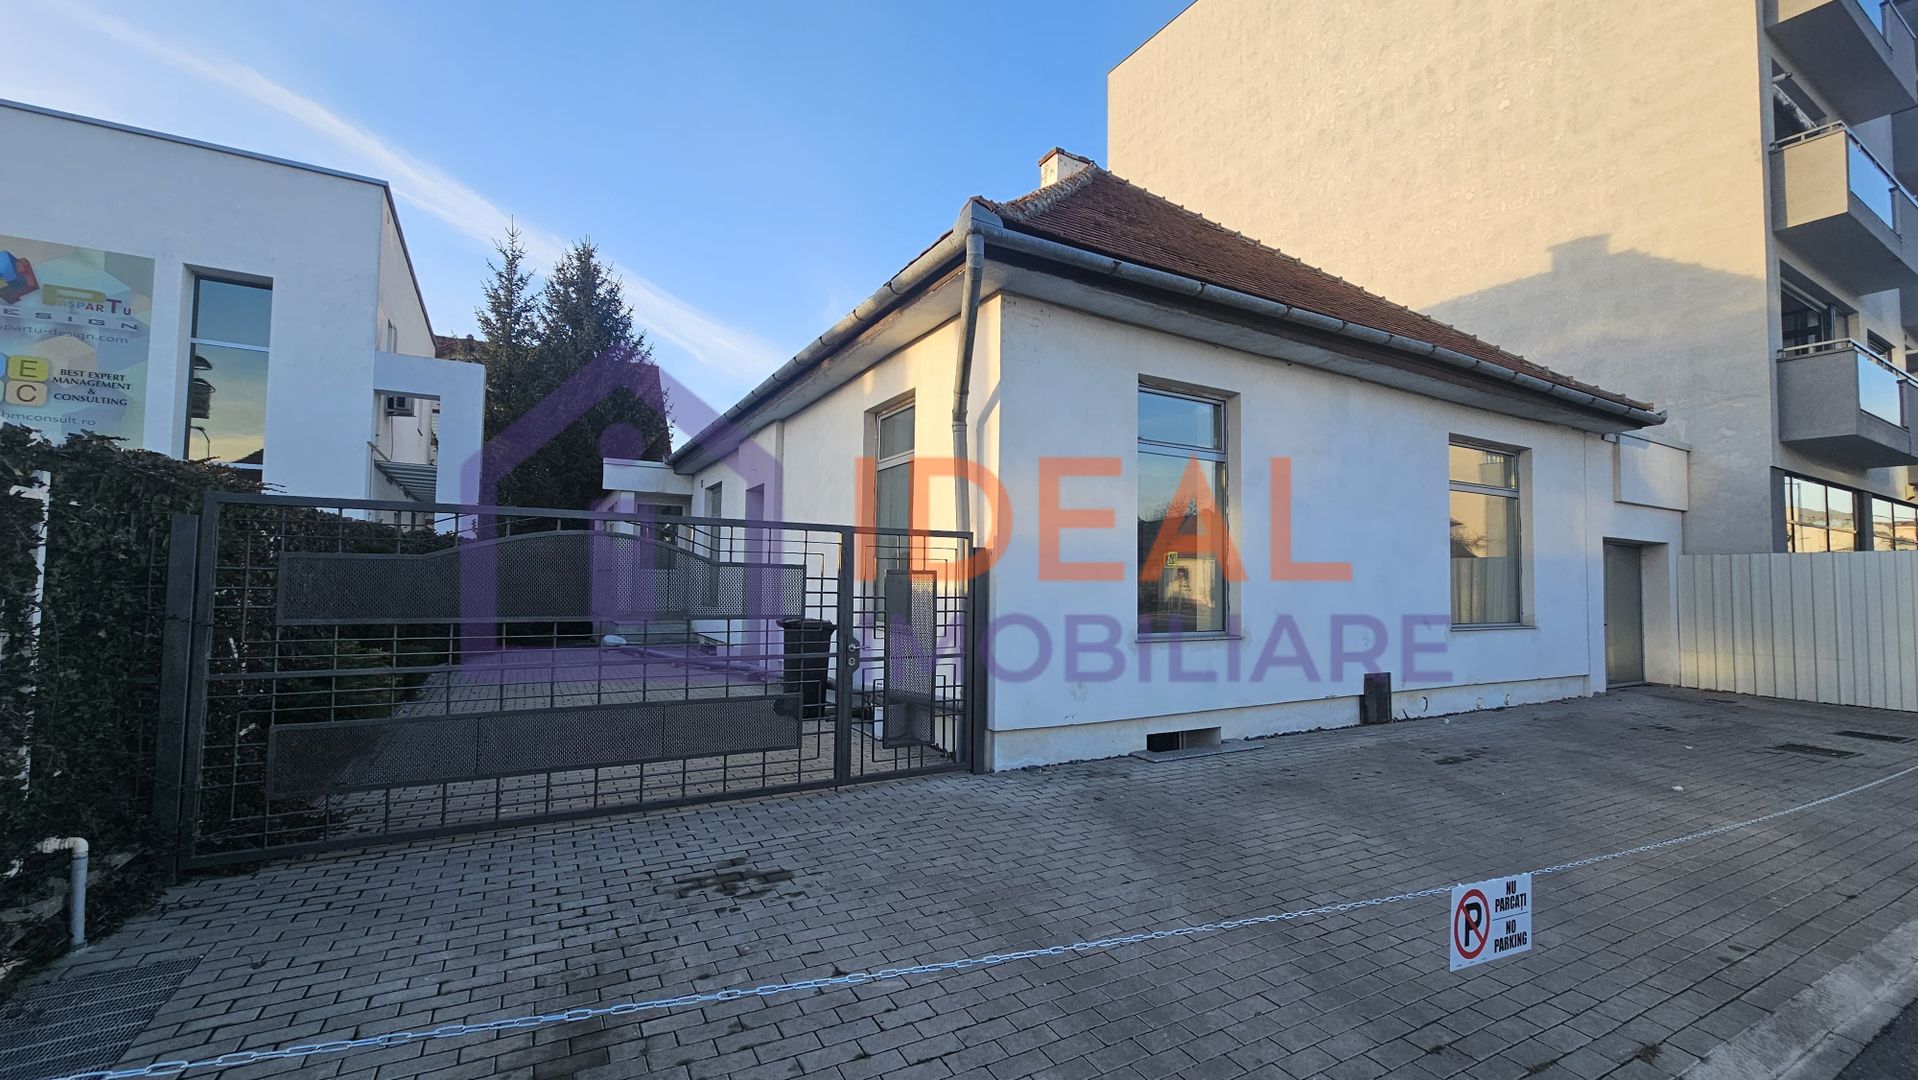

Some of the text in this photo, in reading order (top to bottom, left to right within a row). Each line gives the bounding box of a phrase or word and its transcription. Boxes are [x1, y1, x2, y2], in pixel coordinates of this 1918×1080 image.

[0, 323, 129, 344] partu-design.com
[60, 368, 126, 382] BEST EXPERT
[52, 376, 132, 390] MANAGEMENT
[53, 392, 128, 406] CONSULTING
[1505, 880, 1517, 895] NU
[1505, 919, 1517, 934] NO
[1494, 931, 1528, 953] PARKING
